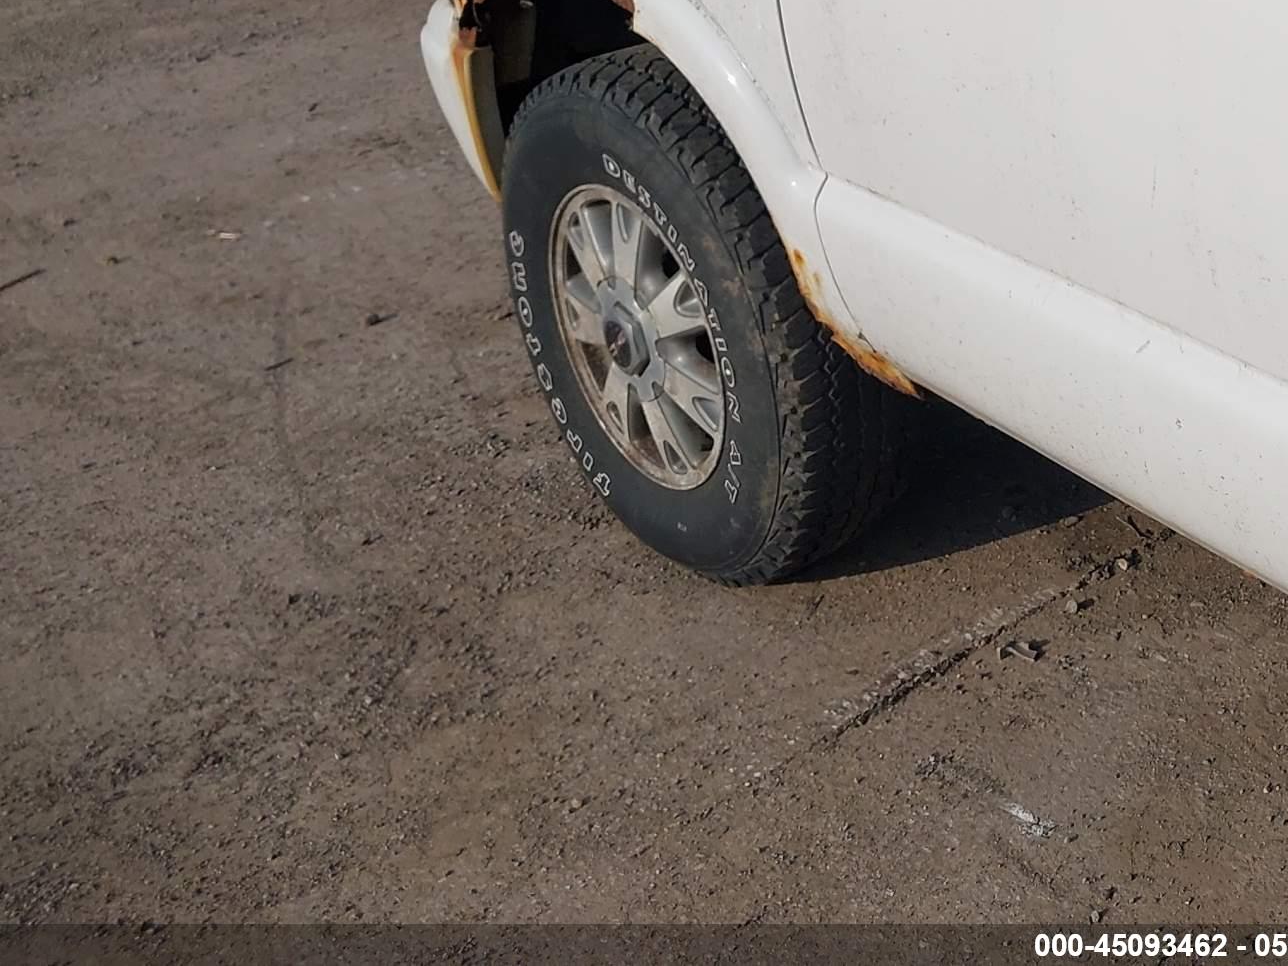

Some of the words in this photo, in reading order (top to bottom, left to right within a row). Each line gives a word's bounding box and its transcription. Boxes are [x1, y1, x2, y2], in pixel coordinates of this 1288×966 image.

[508, 229, 611, 498] FIRESTONE
[602, 153, 741, 424] DESTINATION
[723, 439, 741, 504] A/T
